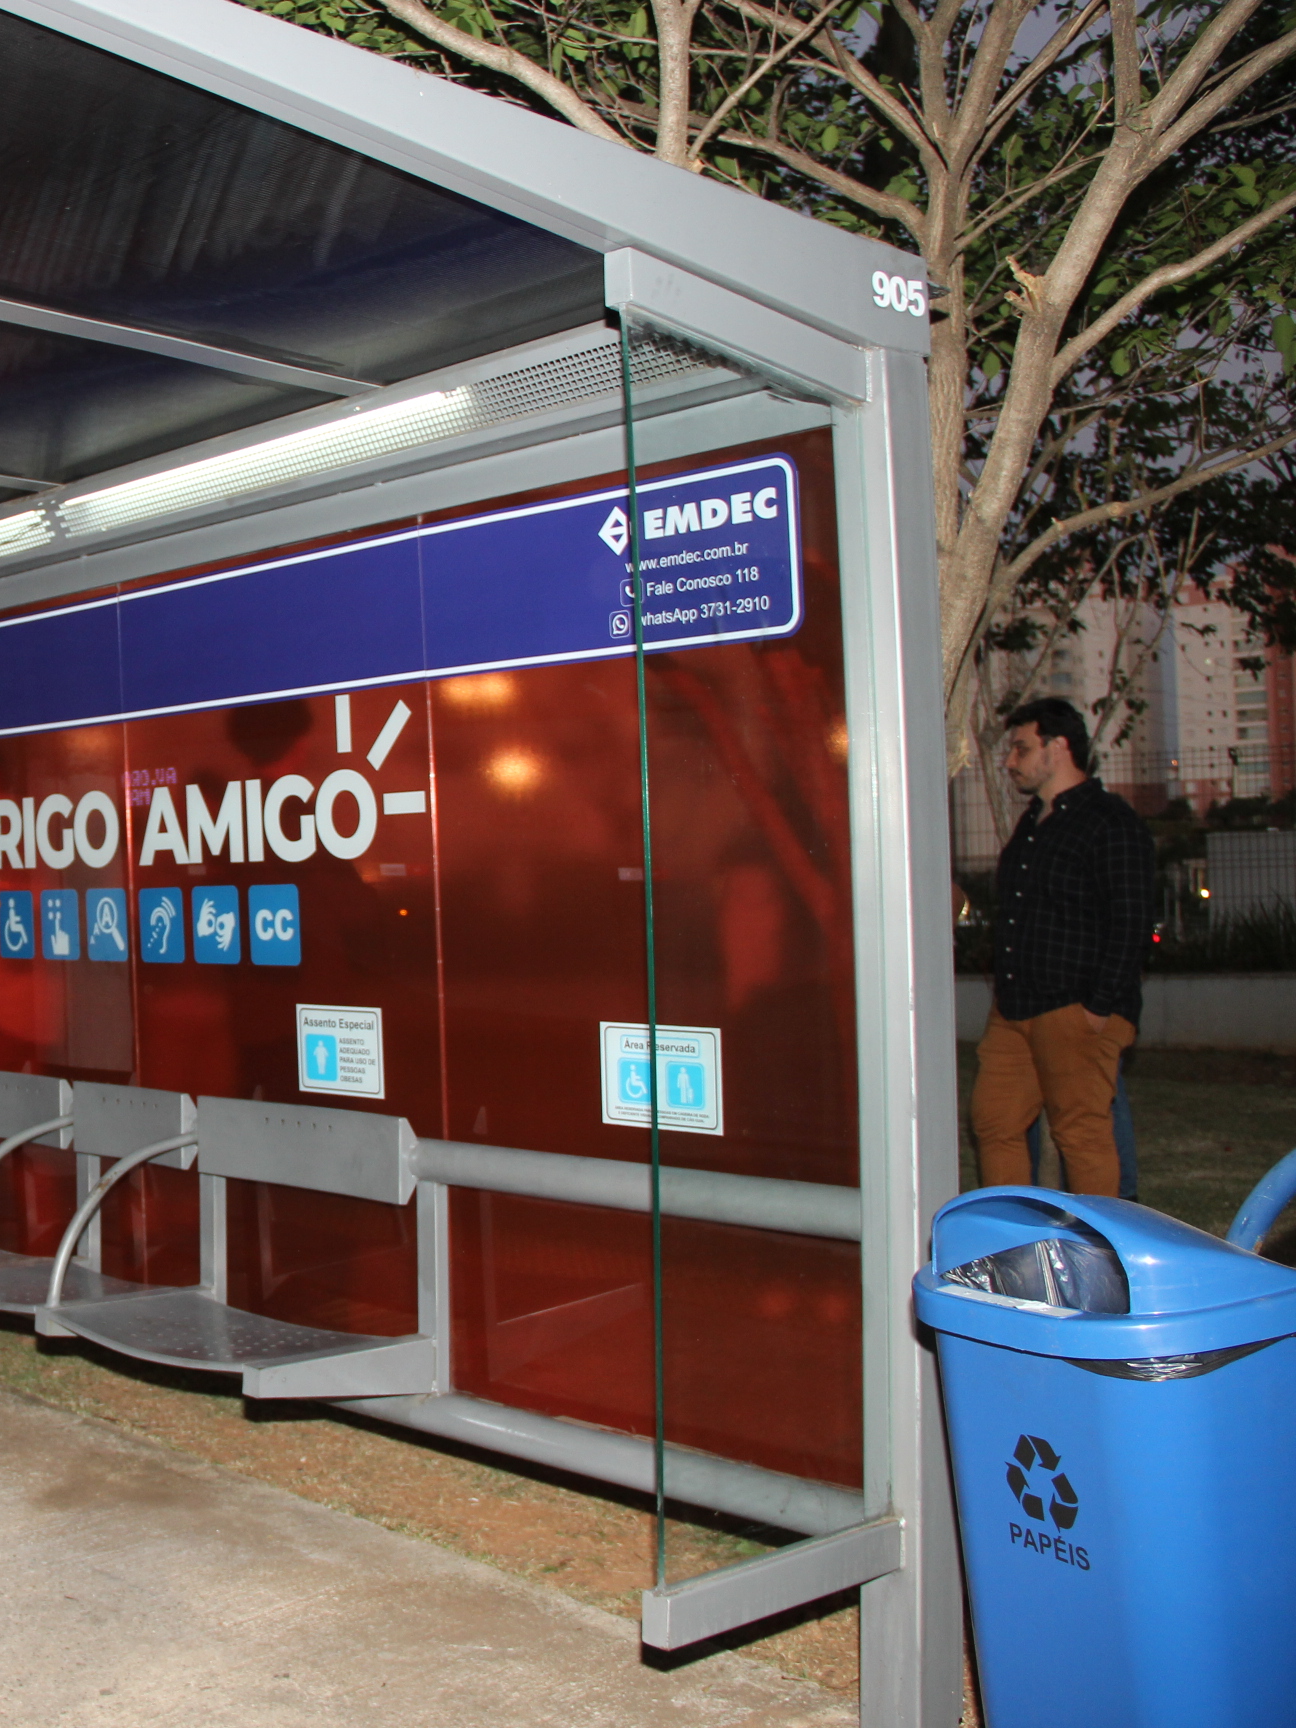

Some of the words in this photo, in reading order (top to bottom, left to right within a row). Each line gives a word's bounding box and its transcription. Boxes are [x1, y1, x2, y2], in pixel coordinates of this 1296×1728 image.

[872, 271, 925, 317] 905
[643, 487, 778, 540] EMDEC
[646, 581, 674, 597] Fale
[677, 573, 732, 592] Conosco
[736, 566, 759, 584] 118
[700, 595, 770, 618] 3731-2910
[138, 768, 378, 866] AMIGO
[255, 908, 294, 941] CC
[303, 1017, 336, 1028] Assento
[339, 1018, 374, 1031] Especial
[339, 1047, 370, 1055] ADEQUADO
[624, 1037, 644, 1050] Área
[340, 1066, 366, 1074] PESSOAS
[340, 1075, 363, 1083] OBESAS
[1009, 1522, 1090, 1571] PAPÉIS
